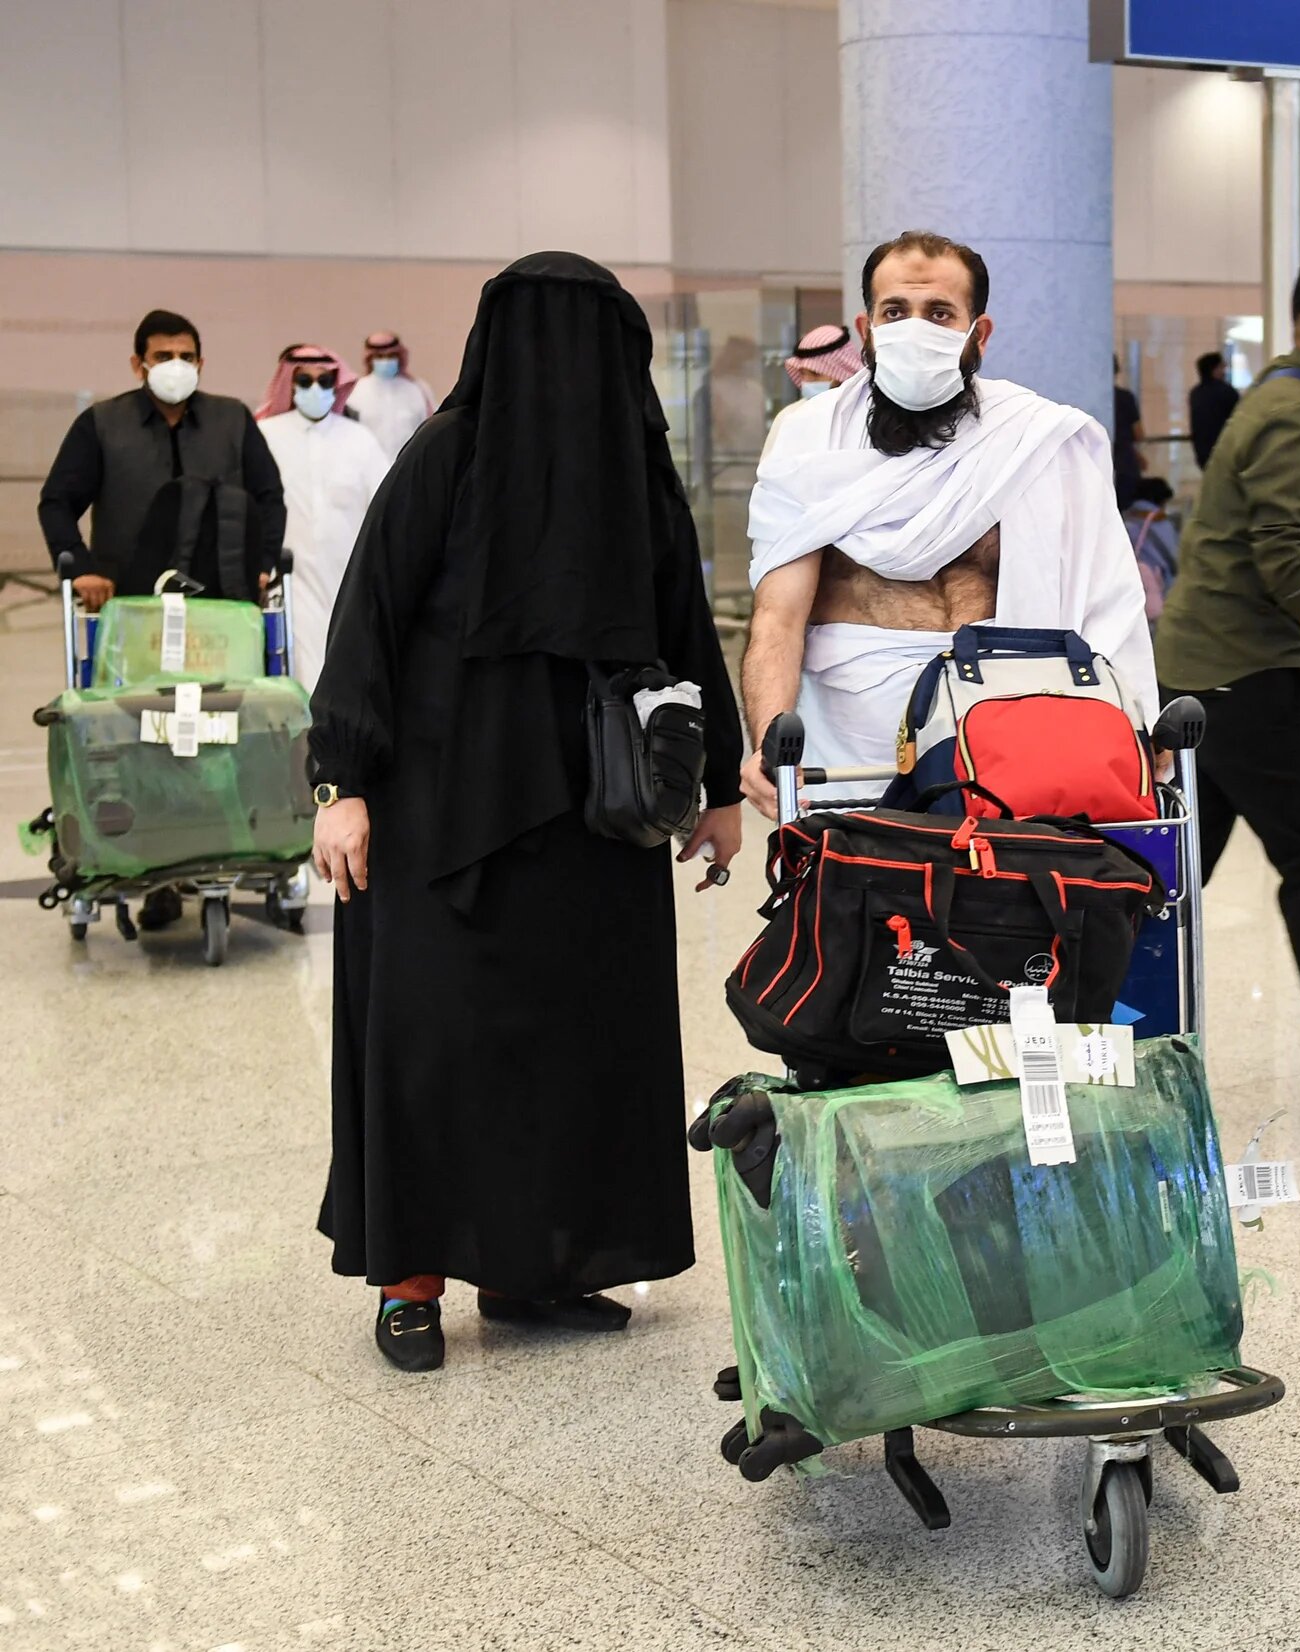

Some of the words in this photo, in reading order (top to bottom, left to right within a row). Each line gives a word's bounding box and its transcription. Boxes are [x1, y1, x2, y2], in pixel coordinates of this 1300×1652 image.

[887, 966, 930, 979] Talbia
[915, 1010, 937, 1018] Block
[1025, 1036, 1046, 1045] JED
